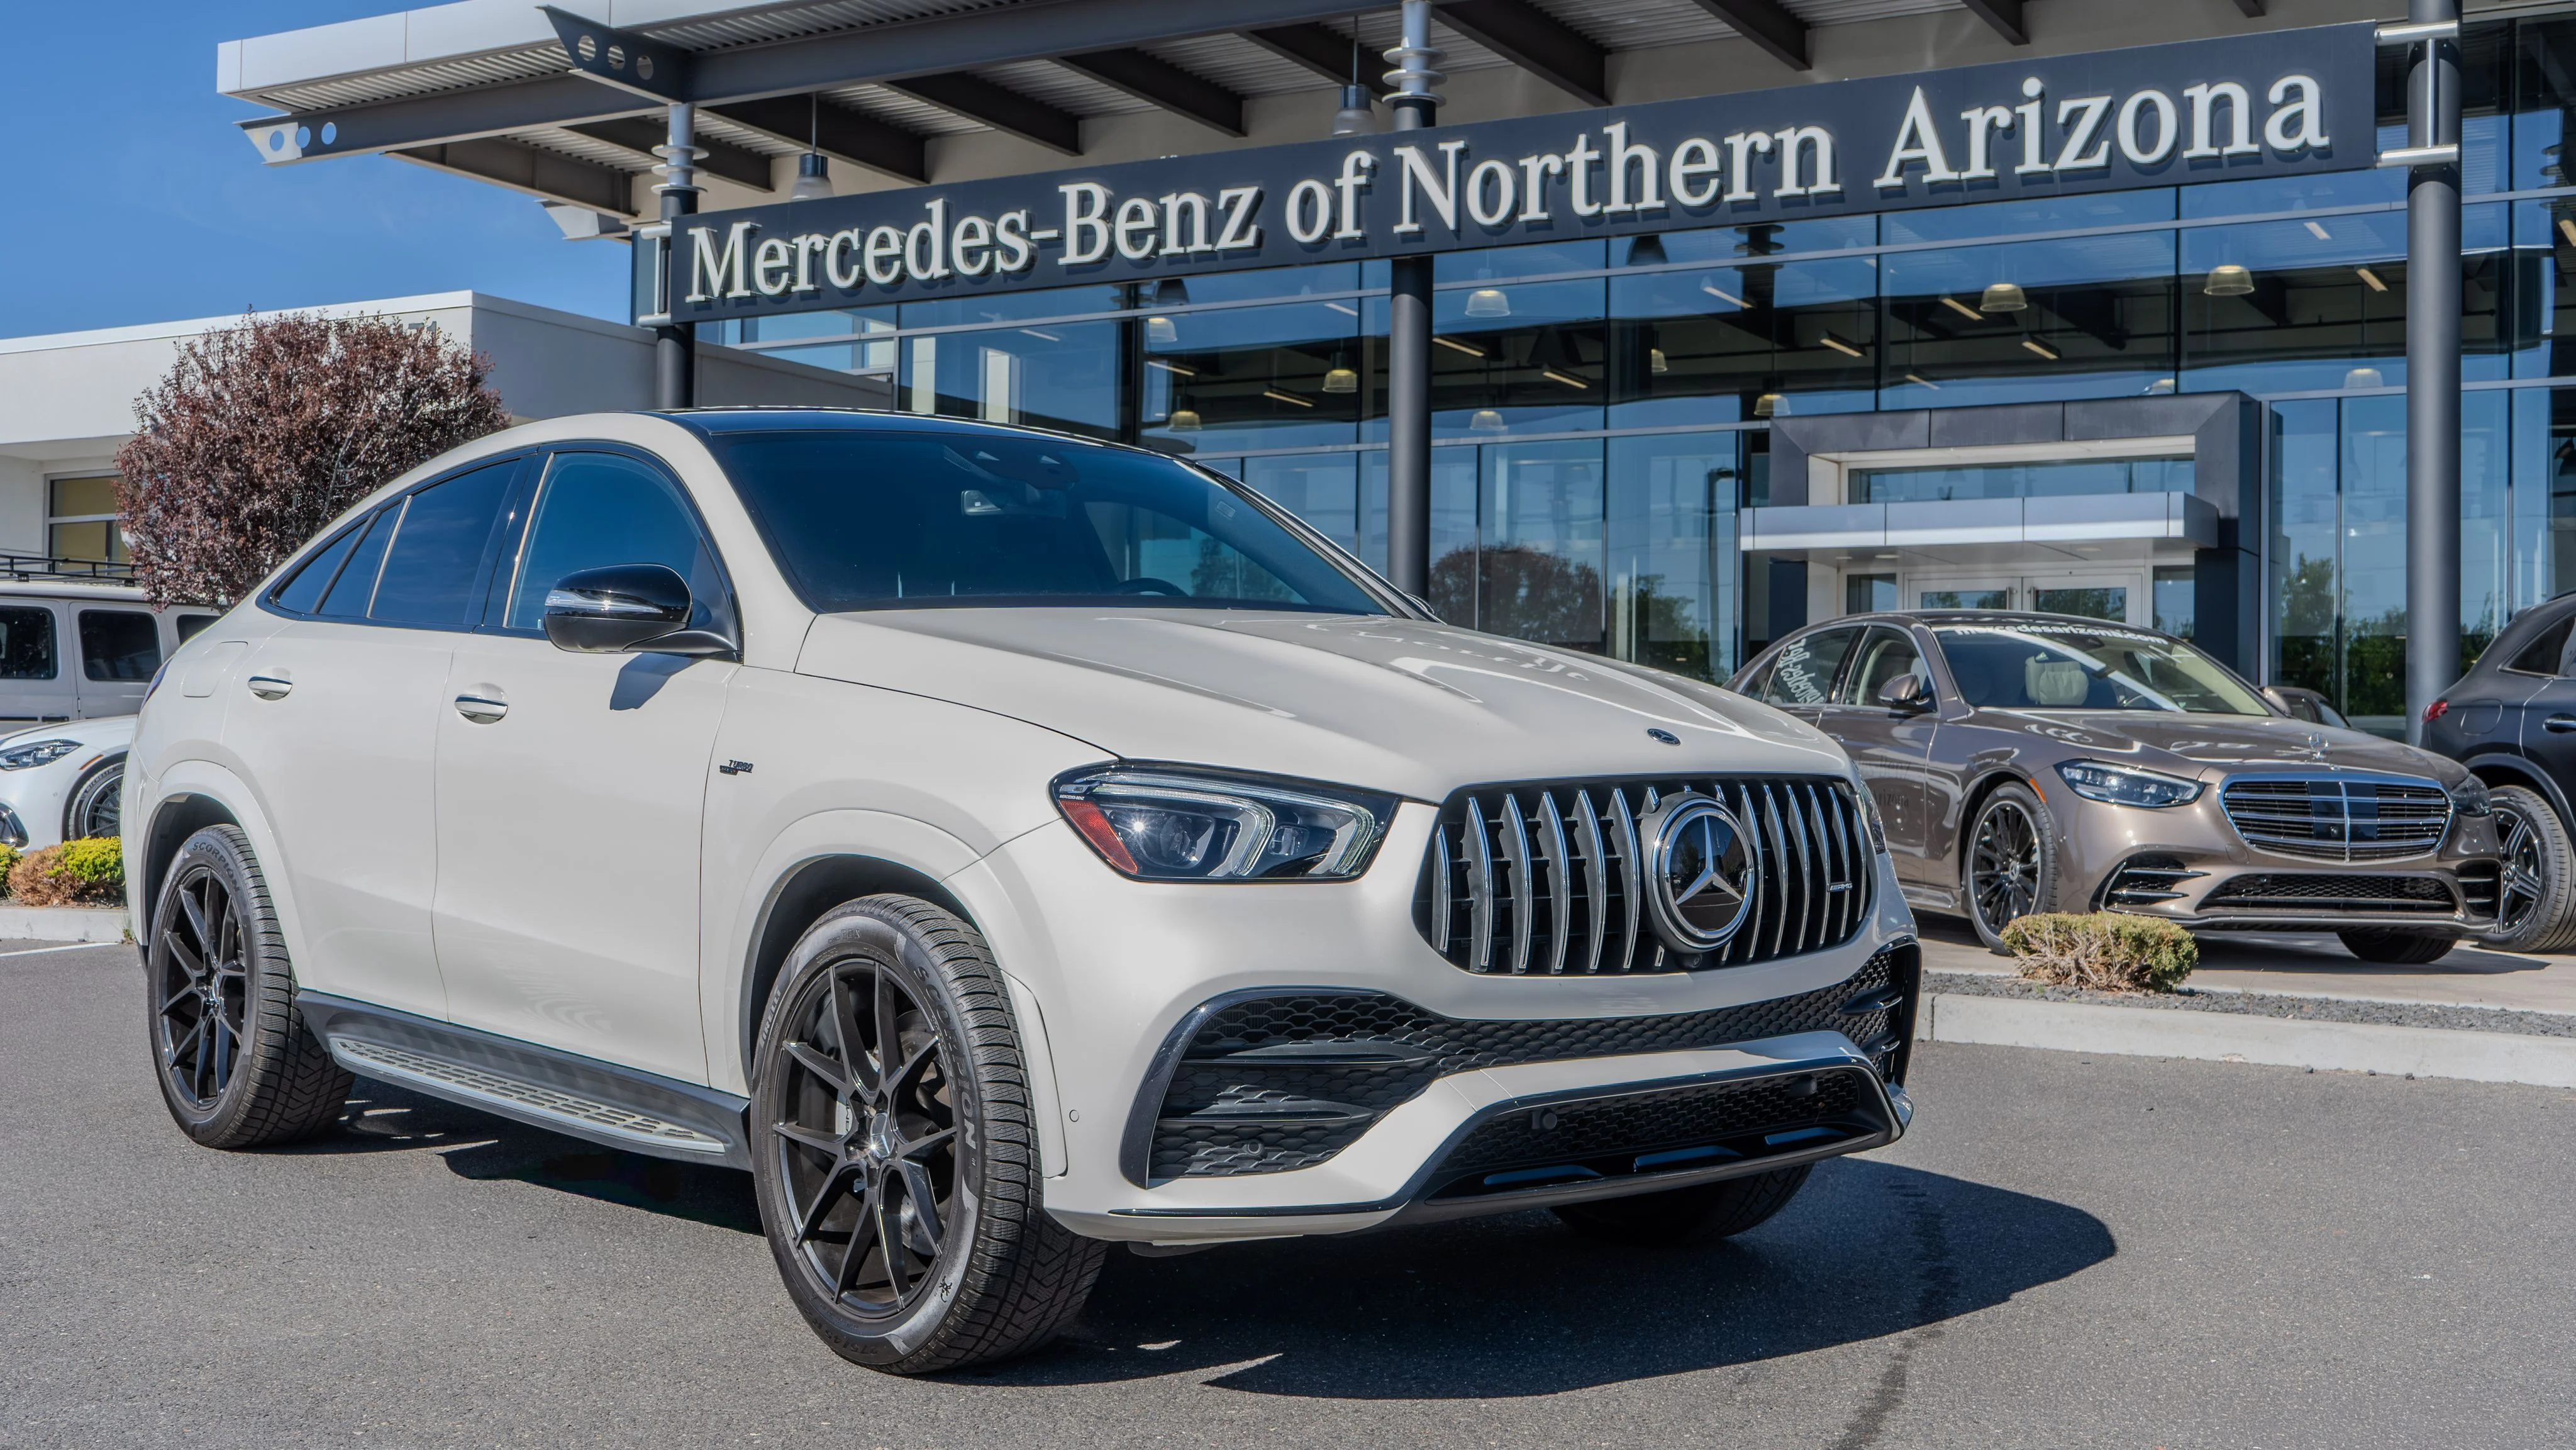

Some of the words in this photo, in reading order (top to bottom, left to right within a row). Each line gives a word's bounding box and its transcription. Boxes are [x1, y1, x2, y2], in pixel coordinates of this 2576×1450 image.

[686, 182, 1262, 303] Mercedes-Benz
[1285, 150, 1378, 243] of
[1394, 121, 1842, 235] Northern
[1873, 74, 2330, 189] Arizona
[193, 842, 240, 892] SCORPION
[759, 985, 781, 1049] PIRELLI
[914, 966, 977, 1150] SCORPION
